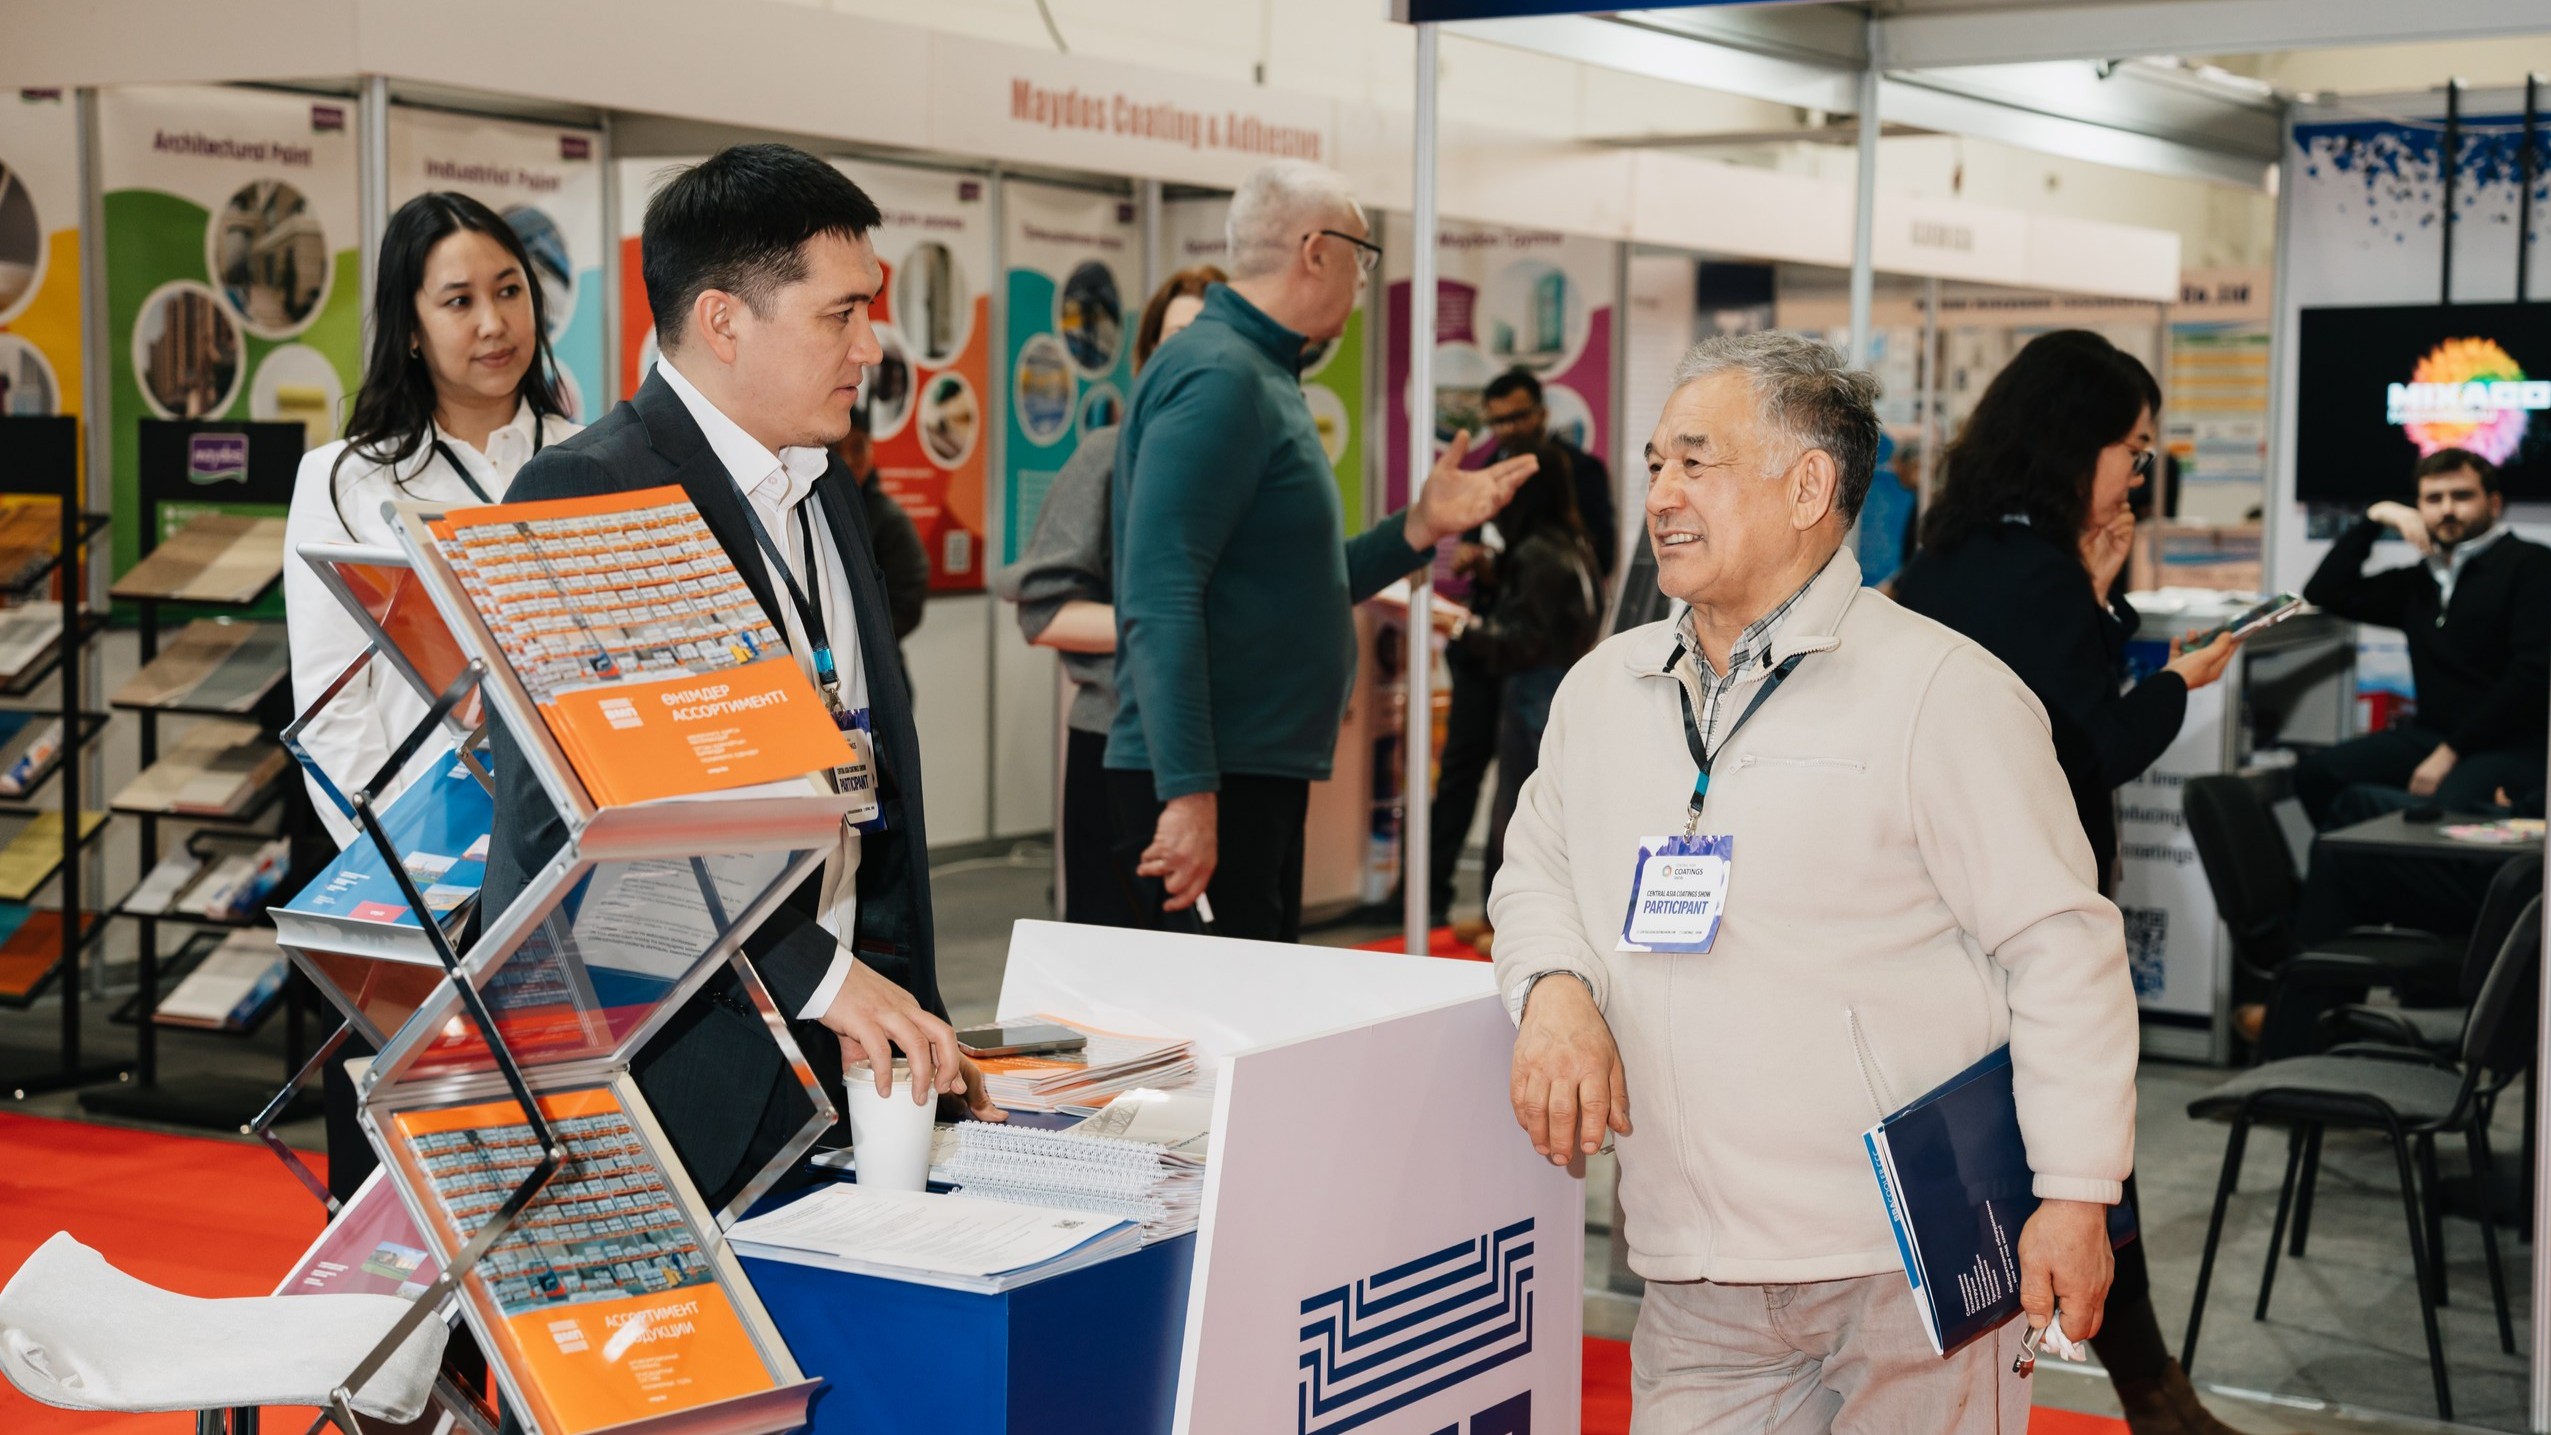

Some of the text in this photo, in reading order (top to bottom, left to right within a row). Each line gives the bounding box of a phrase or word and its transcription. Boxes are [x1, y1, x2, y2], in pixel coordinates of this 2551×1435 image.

[1010, 77, 1320, 162] Maydos Coating & Adhesive
[154, 129, 313, 168] Architectural Paint
[424, 158, 561, 193] Industrial Paint
[661, 684, 730, 706] ӨНІМДЕР
[672, 689, 788, 722] АССОРТИМЕНТІ
[1674, 868, 1704, 876] COATINGS
[1643, 900, 1709, 914] PARTICIPANT
[1985, 1199, 2014, 1294] Лабораторное оборудование
[1957, 1274, 1971, 1317] Смешивание
[1962, 1273, 1976, 1314] Охлаждение
[1969, 1277, 1981, 1312] Экструзия
[1972, 1264, 1987, 1309] Измельчение
[1976, 1253, 1992, 1306] Классификация
[1982, 1259, 1997, 1303] Просеивание
[1991, 1269, 2002, 1300] Упаковка
[622, 1321, 696, 1345] ОДУКЦИИ
